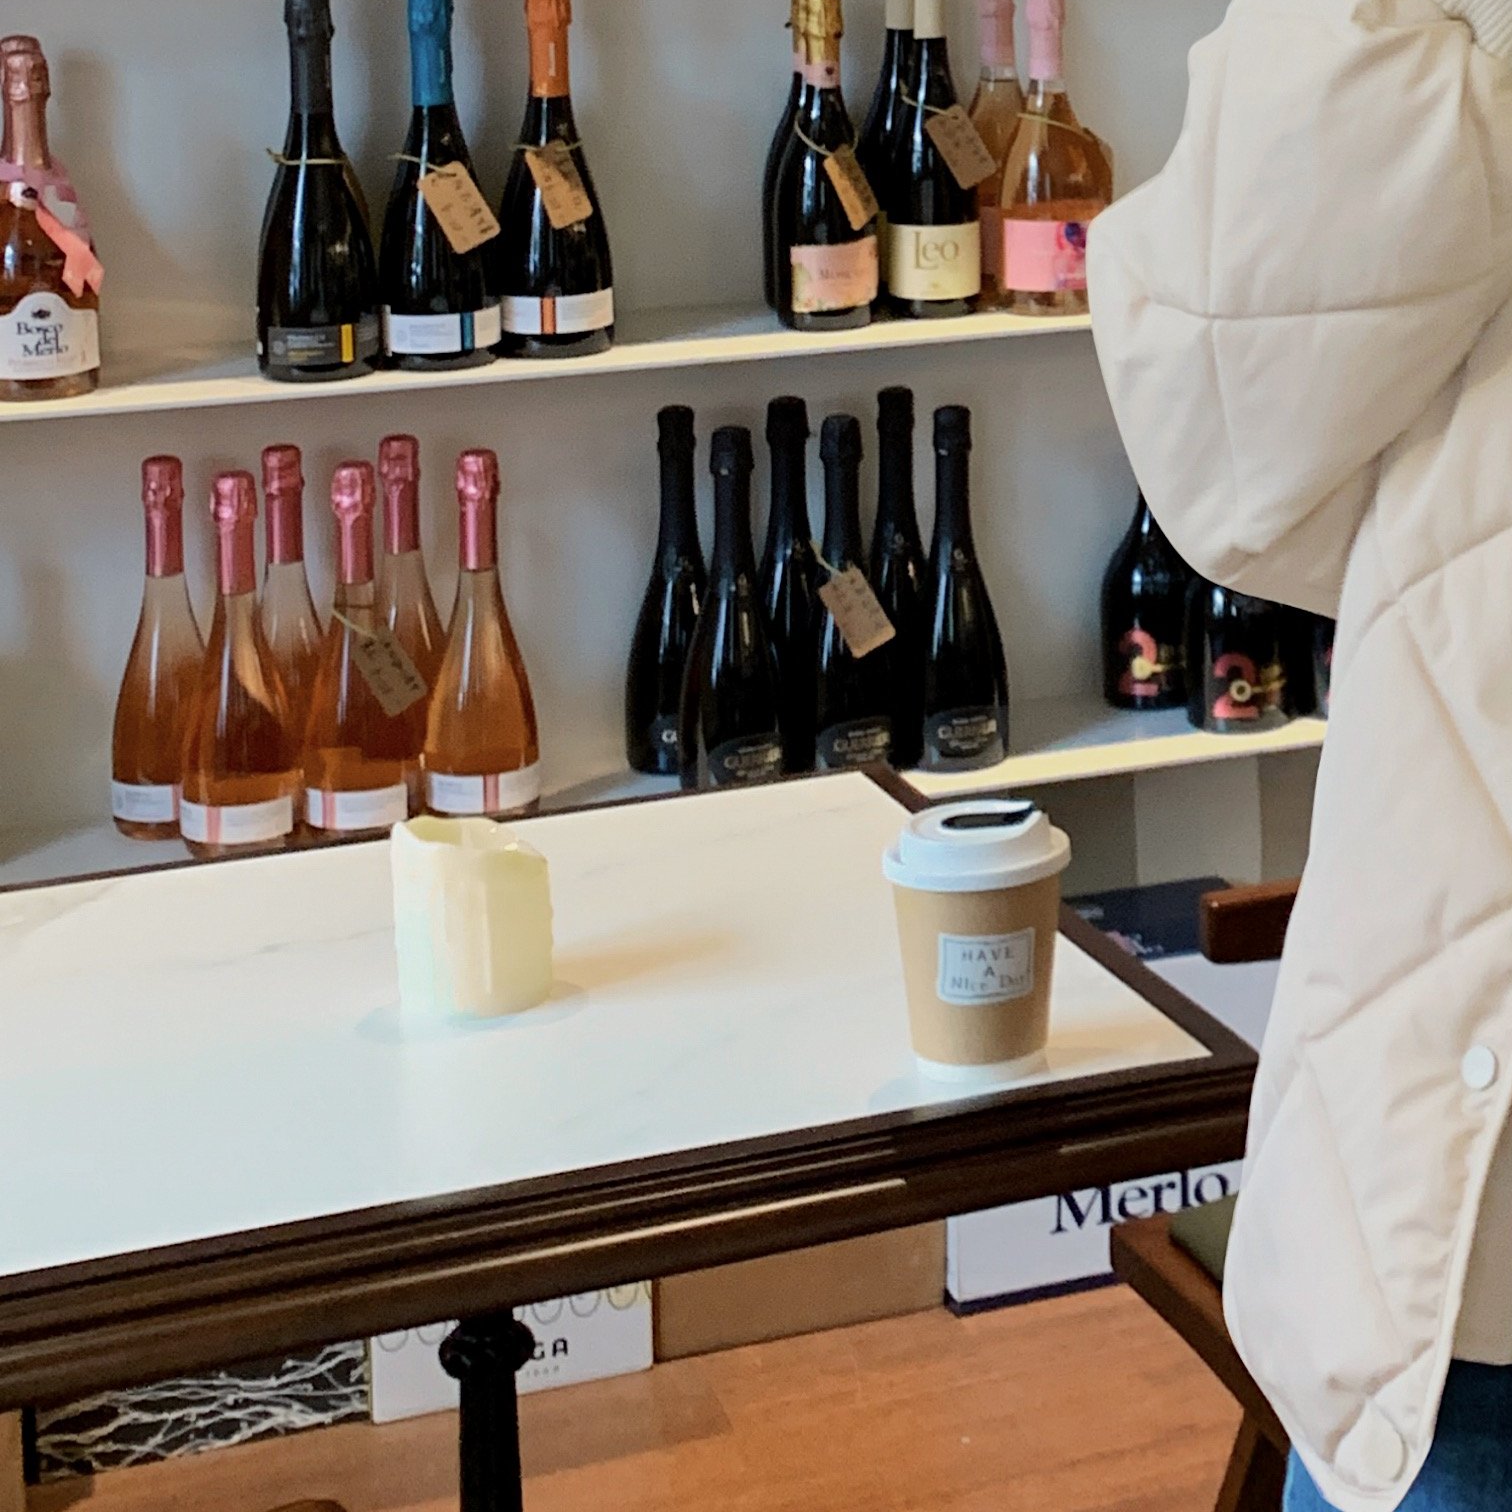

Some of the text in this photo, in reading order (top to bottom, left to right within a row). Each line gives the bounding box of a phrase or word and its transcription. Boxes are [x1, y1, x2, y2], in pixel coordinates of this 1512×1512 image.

[914, 231, 959, 270] Leo
[984, 966, 996, 978] A
[1051, 1169, 1230, 1234] Merlo
